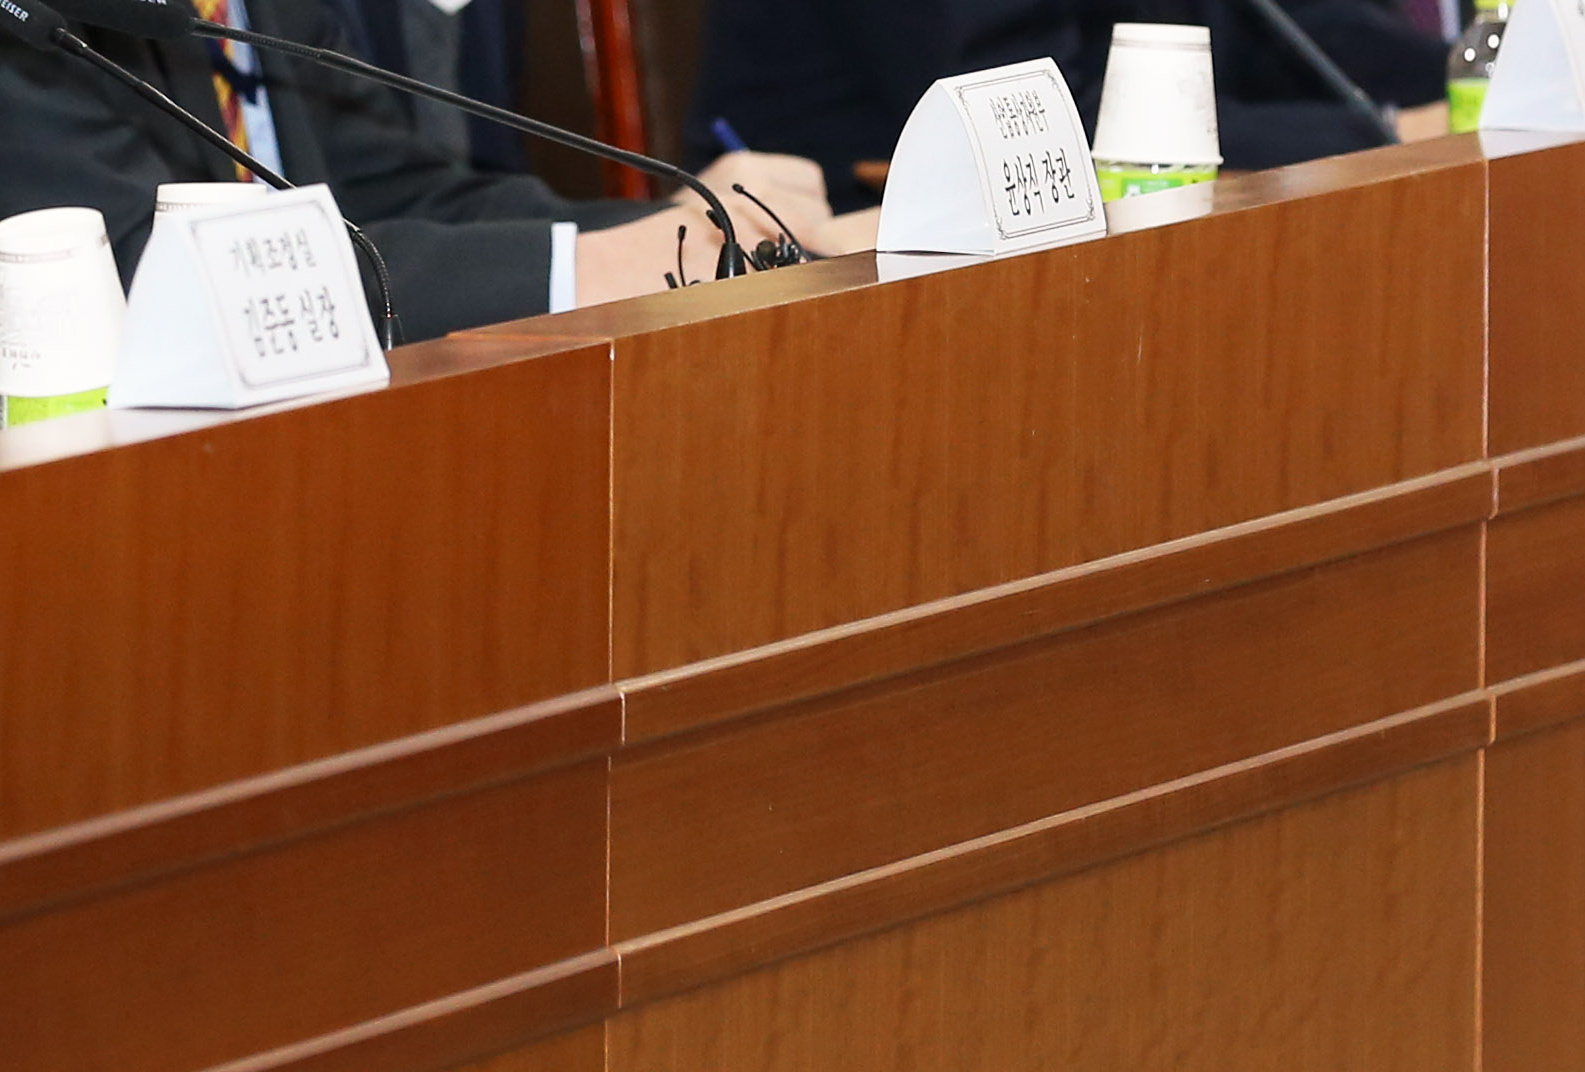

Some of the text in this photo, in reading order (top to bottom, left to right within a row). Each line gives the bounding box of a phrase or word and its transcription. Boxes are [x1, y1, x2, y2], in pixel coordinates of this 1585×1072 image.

[989, 89, 1050, 139] 산업통상자원부
[1003, 147, 1075, 216] 윤상직 장관
[230, 228, 317, 278] 기획조정실
[243, 285, 340, 359] 김준동 실장
